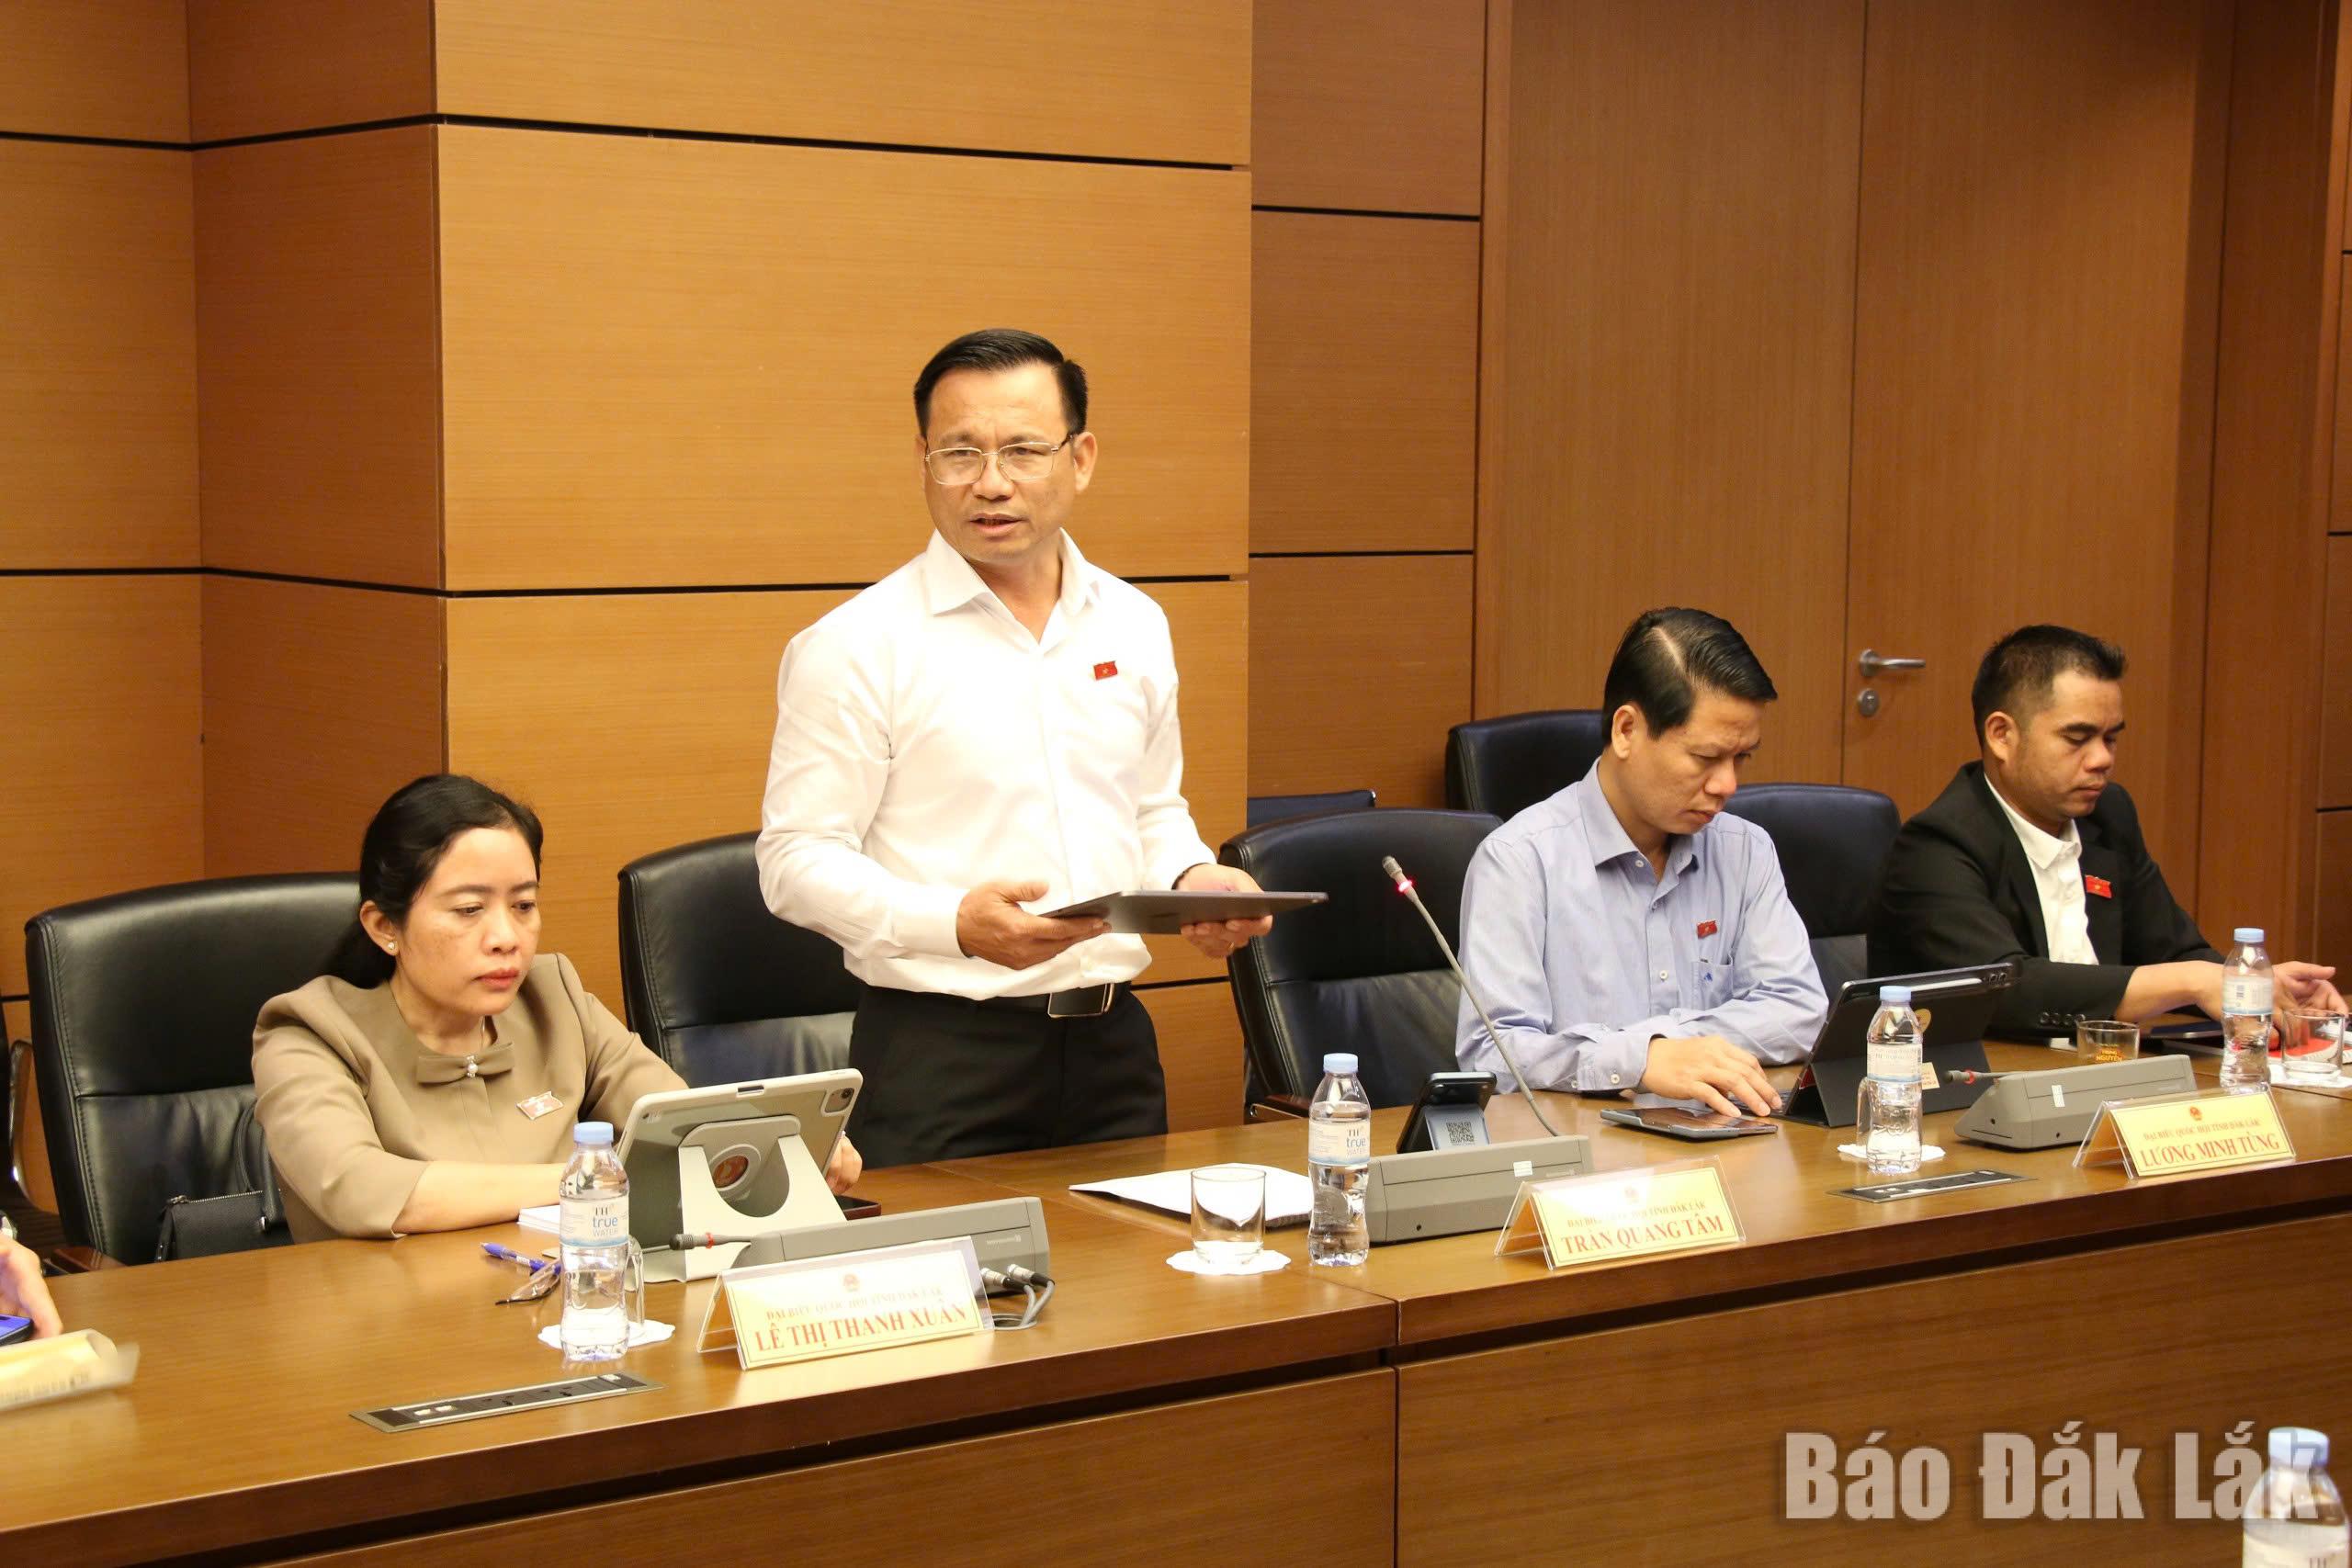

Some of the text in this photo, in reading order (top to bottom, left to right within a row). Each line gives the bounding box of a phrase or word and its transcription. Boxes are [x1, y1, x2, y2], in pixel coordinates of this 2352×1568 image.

[1346, 1138, 1366, 1147] true
[2196, 1138, 2237, 1160] MINH
[2237, 1132, 2279, 1155] TÙNG
[593, 1216, 618, 1228] true
[1616, 1220, 1681, 1248] QUANG
[1681, 1213, 1725, 1235] TÂM
[754, 1298, 968, 1352] LÊ THỊ THANH XUÂN
